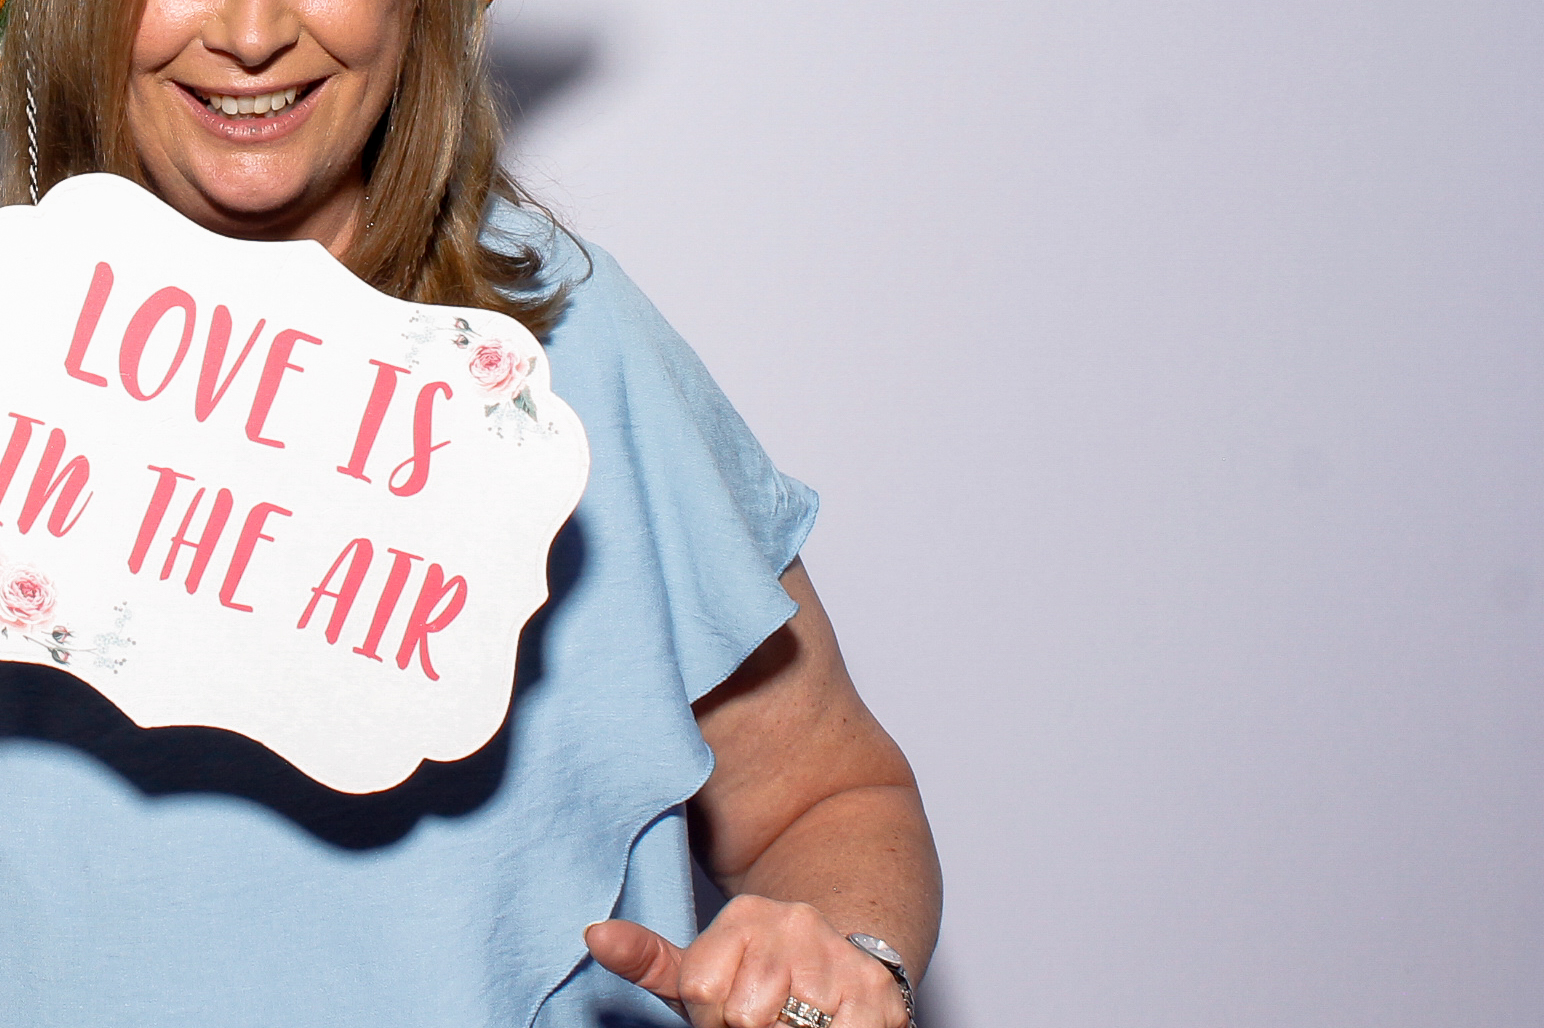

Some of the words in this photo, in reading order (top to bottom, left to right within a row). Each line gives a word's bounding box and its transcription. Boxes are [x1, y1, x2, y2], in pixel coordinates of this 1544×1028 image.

[64, 261, 323, 449] LOVE
[336, 359, 454, 497] IS
[127, 464, 293, 614] THE
[296, 538, 468, 682] AIR
